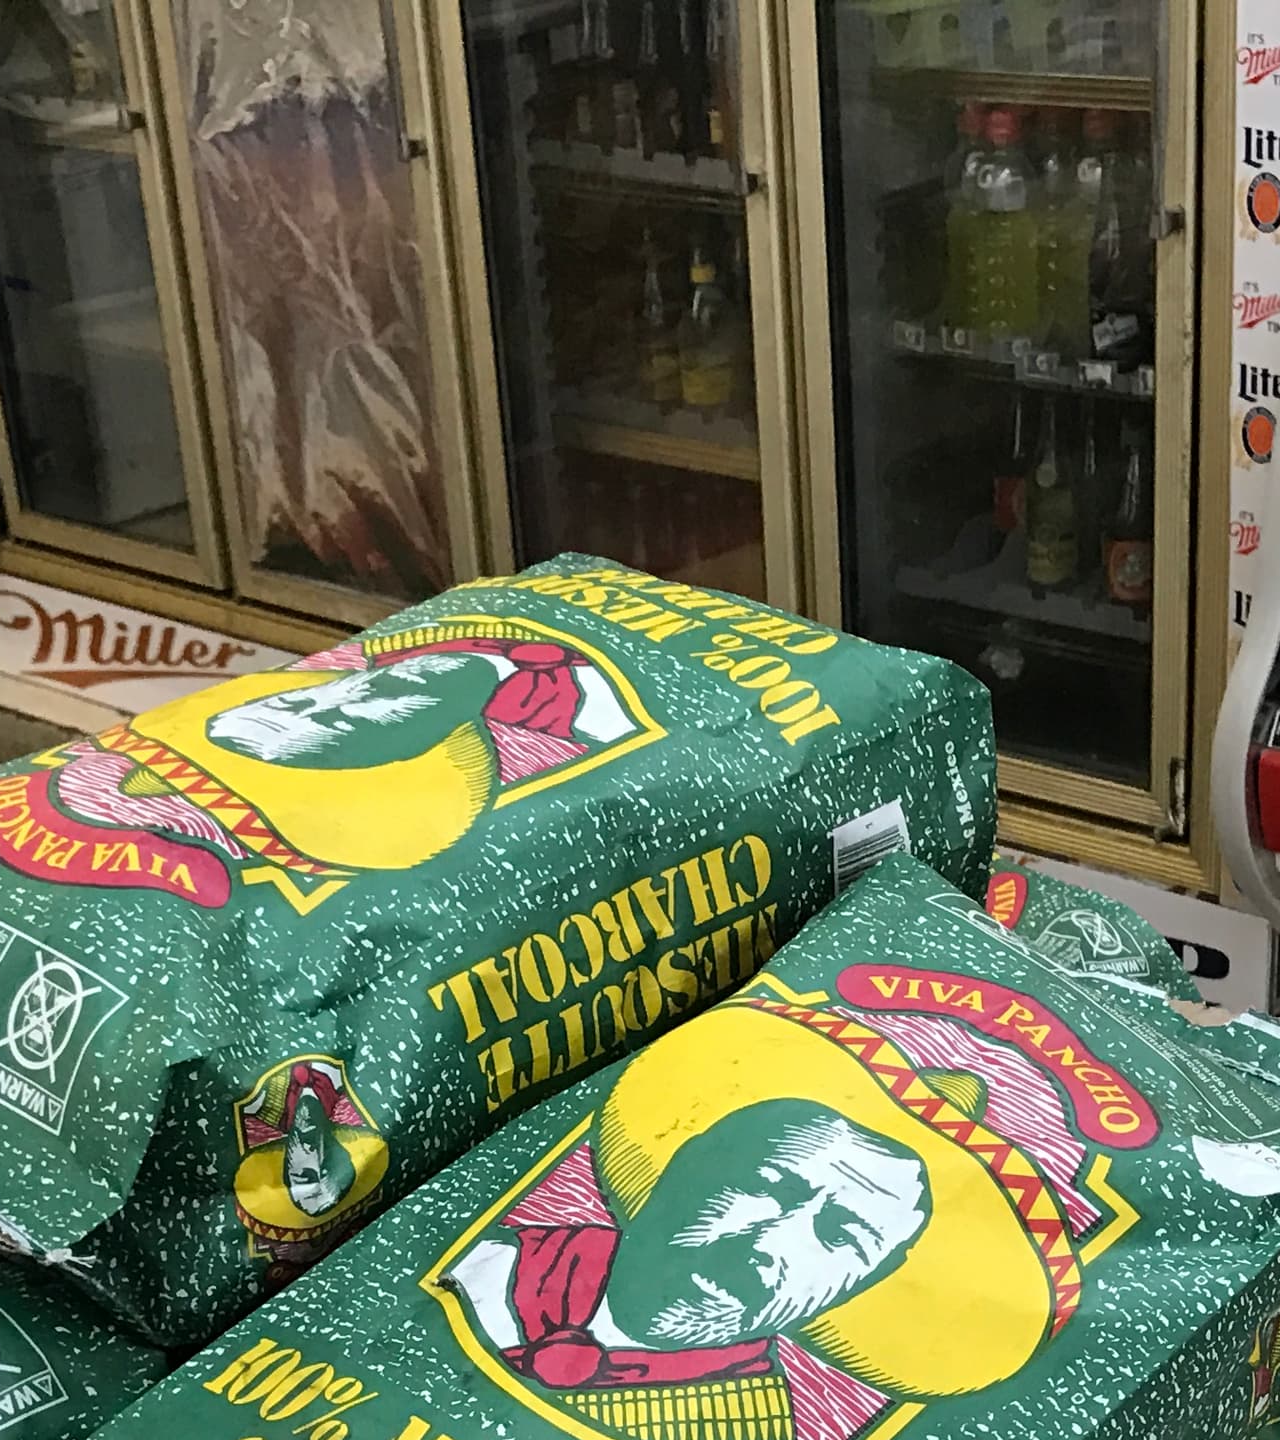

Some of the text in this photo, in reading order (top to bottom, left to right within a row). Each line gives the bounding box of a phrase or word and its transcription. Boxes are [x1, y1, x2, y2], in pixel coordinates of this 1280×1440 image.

[1248, 33, 1264, 44] IT'S
[691, 633, 842, 746] 100%
[945, 741, 974, 825] Mexico
[91, 841, 200, 896] VIVA
[428, 834, 773, 1045] CHARCOAL
[477, 902, 780, 1112] MESQUITE
[868, 974, 1141, 1135] VIVA PANCHO
